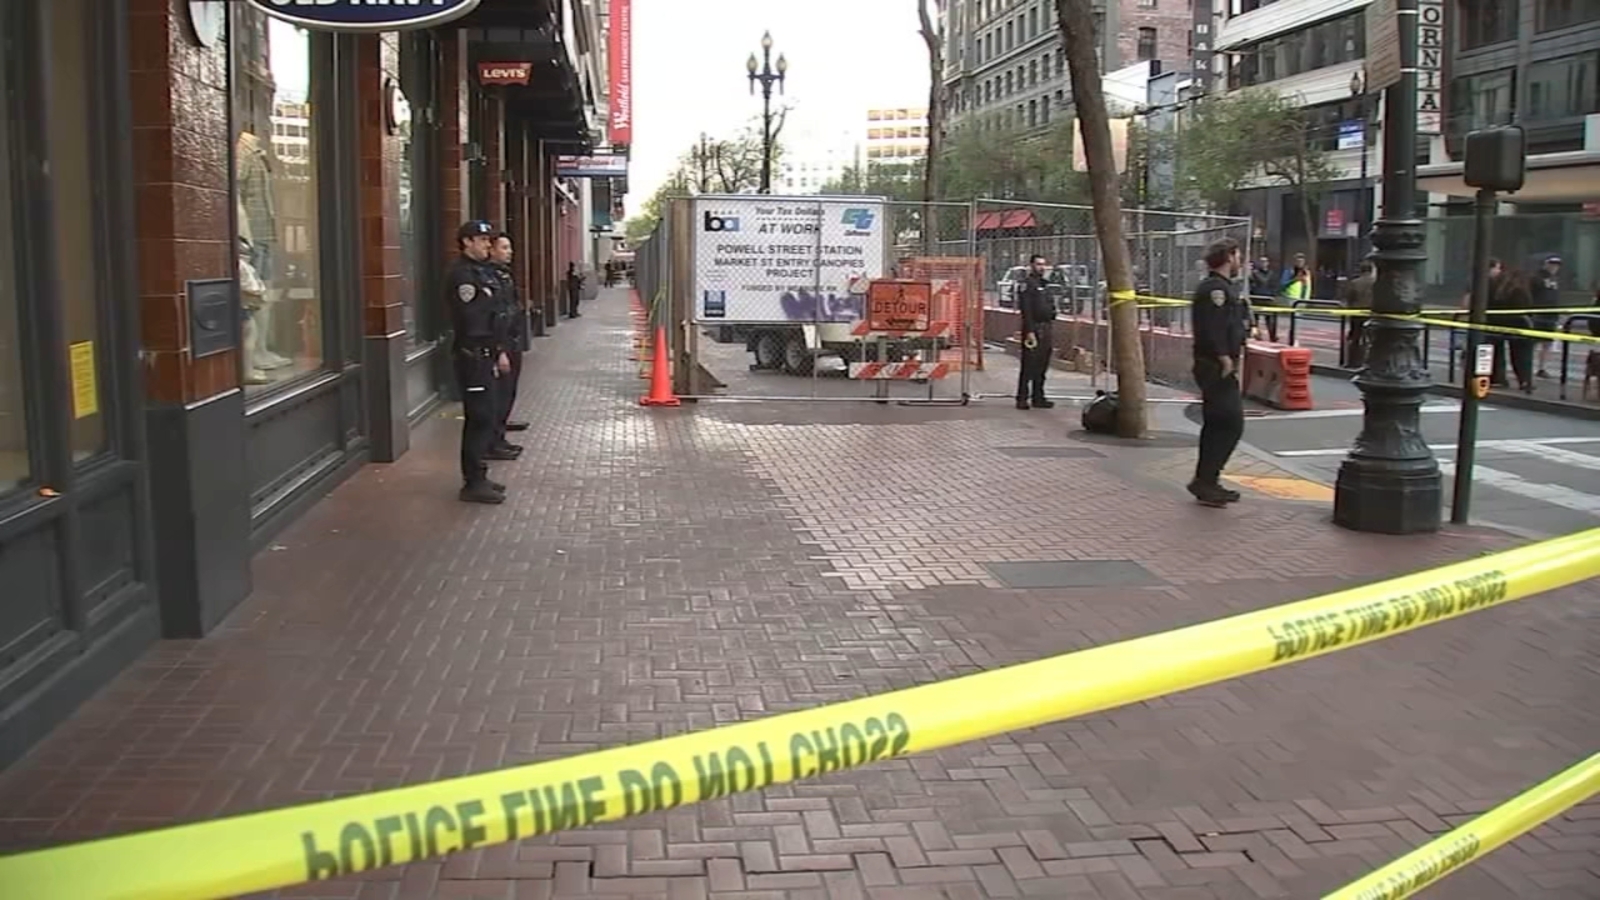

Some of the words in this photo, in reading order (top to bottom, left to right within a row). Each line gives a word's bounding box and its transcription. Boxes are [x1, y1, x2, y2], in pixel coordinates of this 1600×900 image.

[758, 223, 777, 234] AT
[716, 244, 764, 255] POWELL
[768, 244, 812, 255] STREET
[714, 258, 758, 267] MARKET
[761, 258, 773, 267] ST
[777, 258, 809, 268] ENTRY
[766, 269, 814, 278] PROJECT
[873, 301, 926, 314] DETOUR
